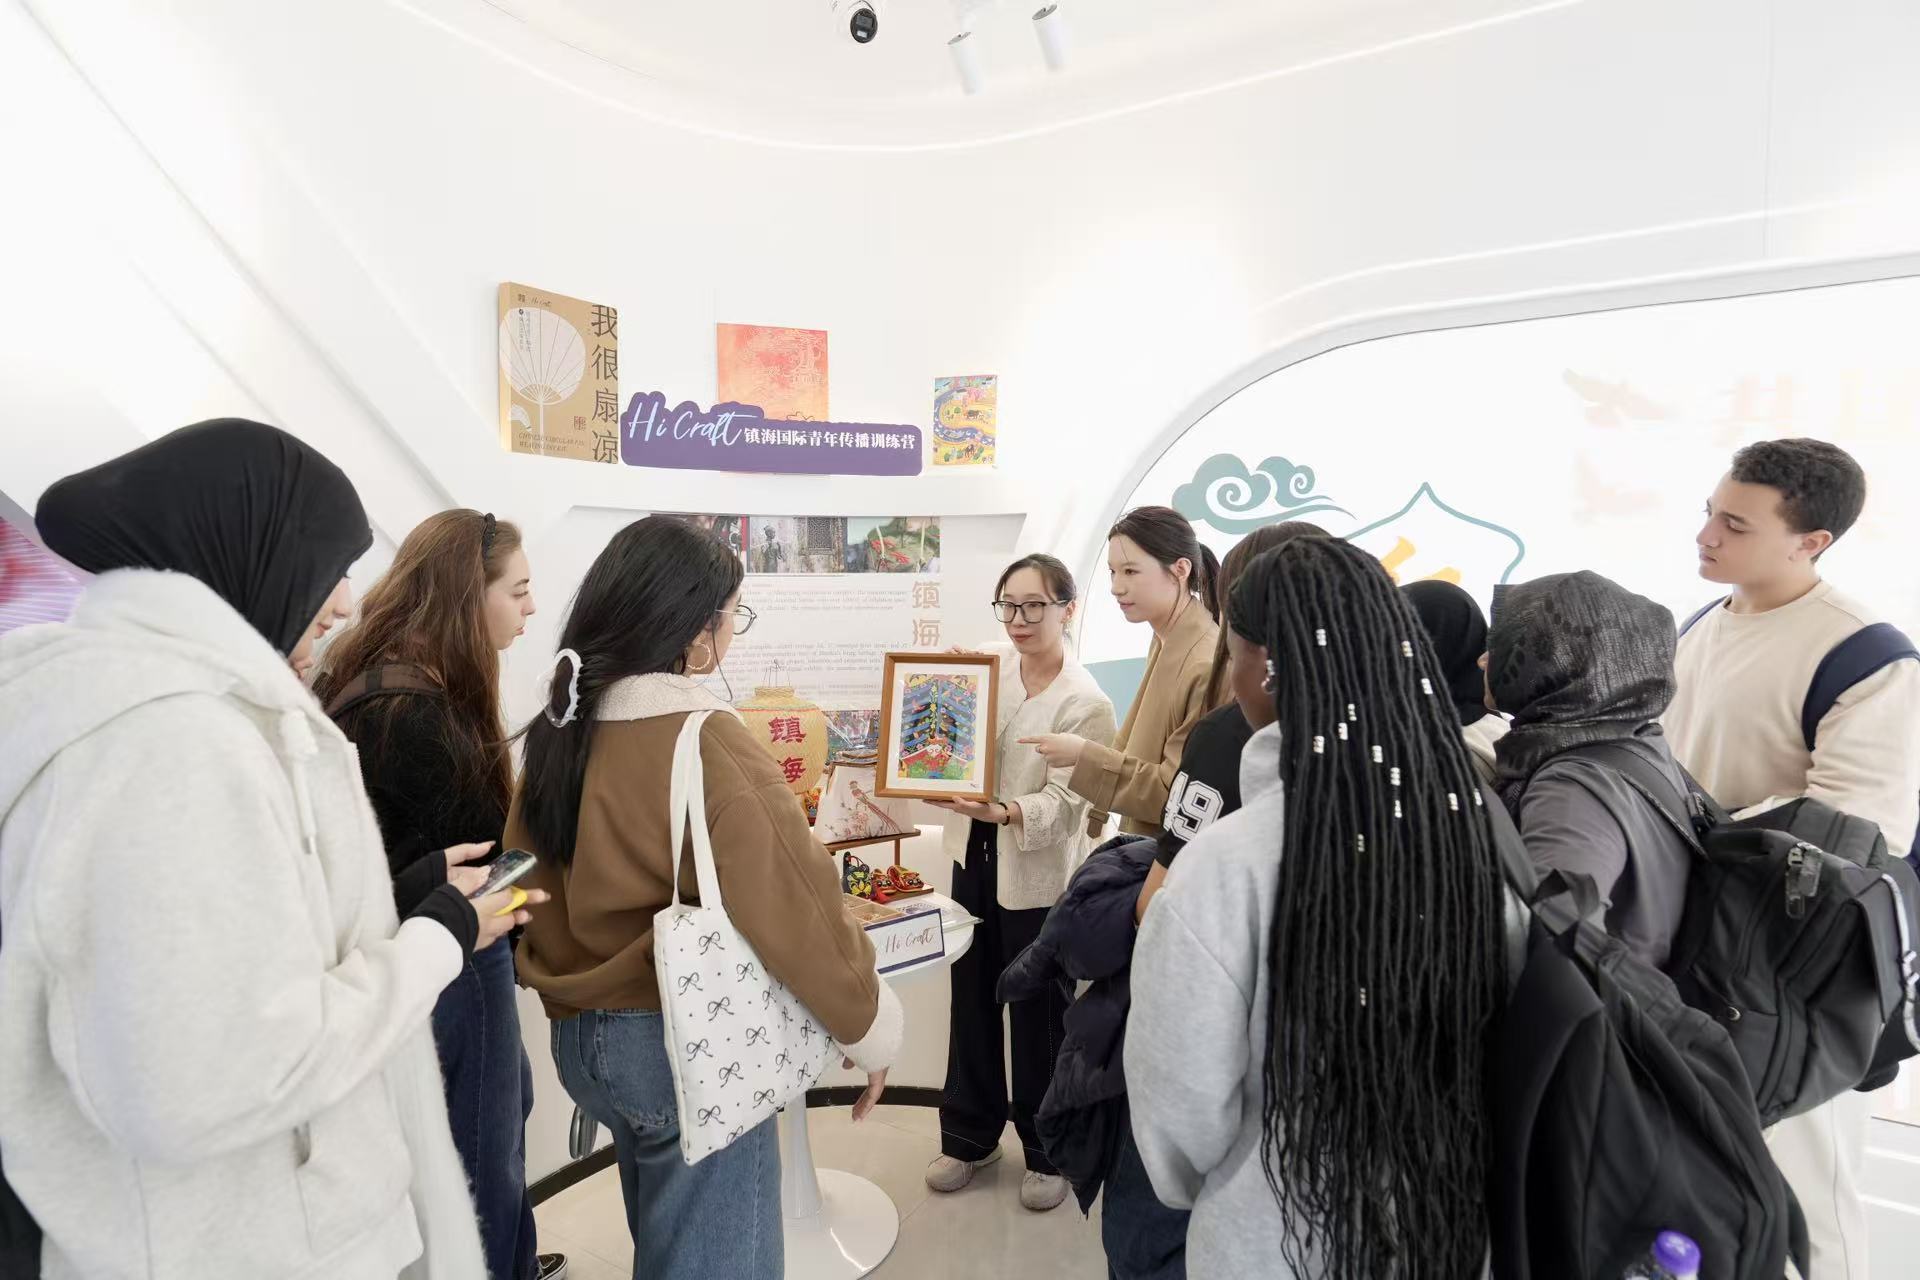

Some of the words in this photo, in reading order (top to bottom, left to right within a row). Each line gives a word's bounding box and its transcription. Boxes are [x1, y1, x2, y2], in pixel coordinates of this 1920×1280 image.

[591, 304, 618, 464] 我很扇凉
[628, 401, 667, 441] Hi
[673, 411, 756, 446] Craft
[743, 426, 915, 450] 镇海国际青年传播训练营
[1163, 771, 1224, 842] 19
[906, 926, 938, 947] Craft
